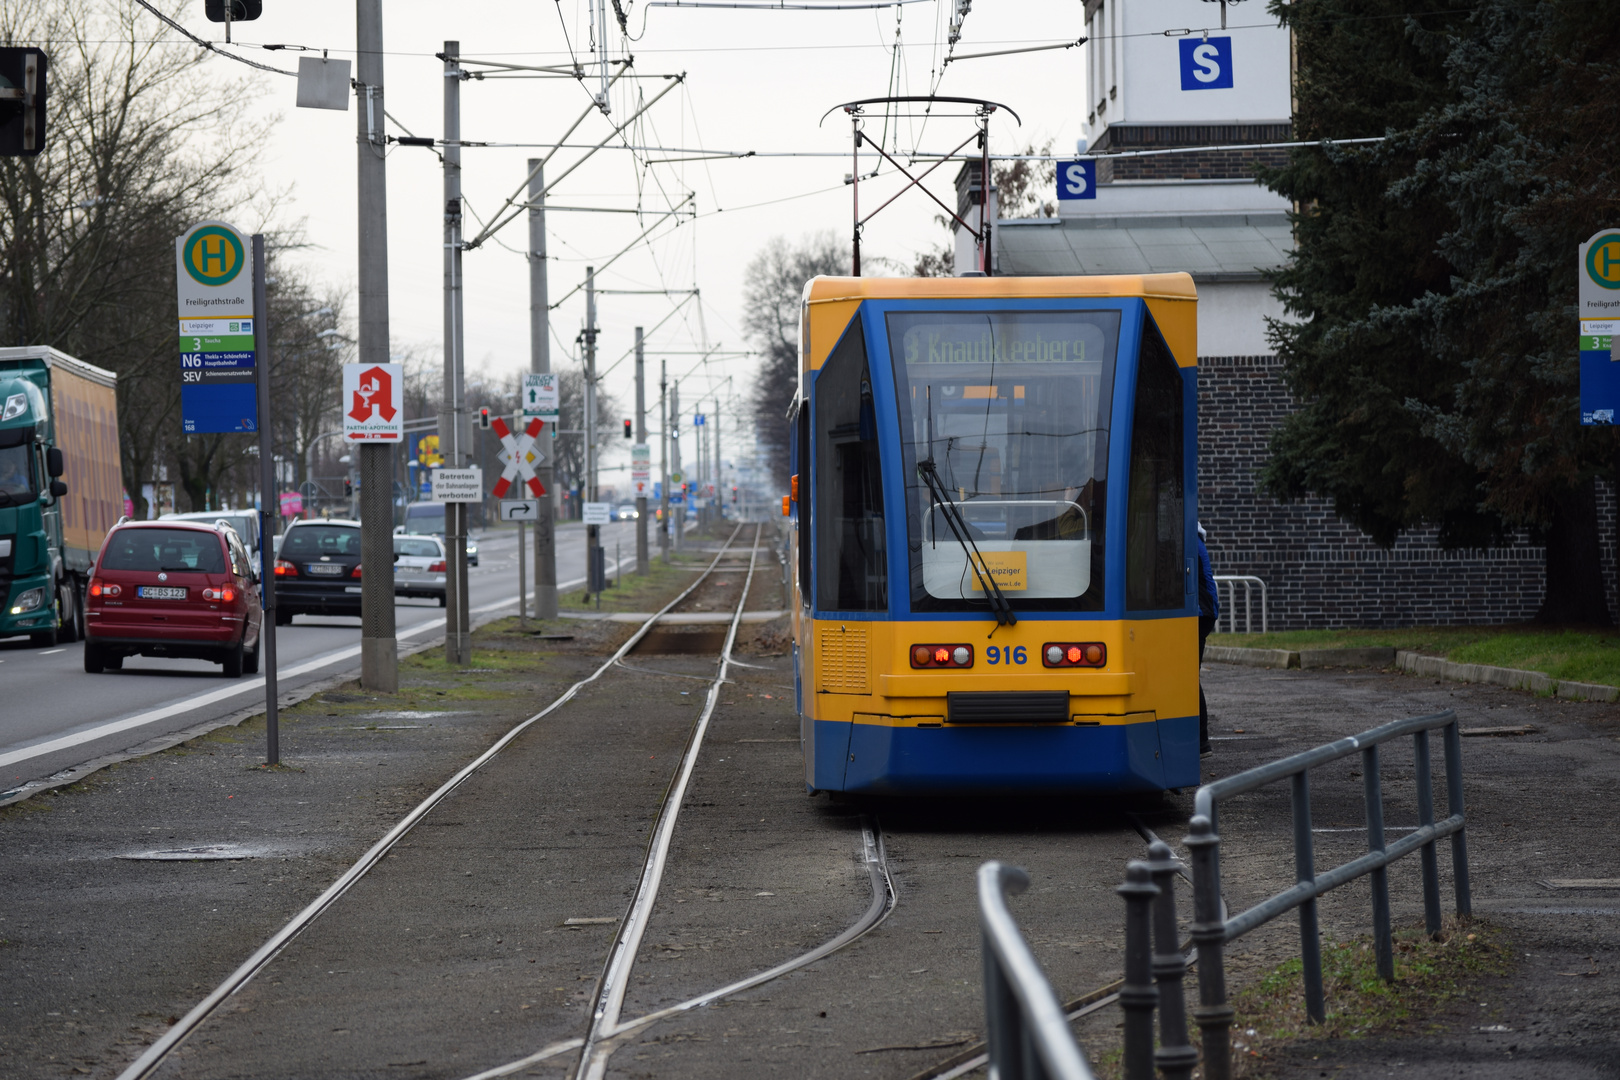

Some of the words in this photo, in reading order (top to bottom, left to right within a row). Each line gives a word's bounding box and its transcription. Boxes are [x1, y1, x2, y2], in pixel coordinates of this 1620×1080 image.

[1193, 44, 1220, 83] S
[1066, 165, 1087, 194] S
[201, 239, 226, 272] H
[185, 296, 245, 307] Freiligrathstraße
[192, 338, 202, 351] 3
[906, 333, 919, 363] 3
[1592, 336, 1600, 349] 3
[182, 354, 202, 368] N6
[183, 371, 202, 382] SEV
[142, 588, 152, 596] GC
[158, 588, 168, 596] BS
[170, 589, 184, 597] 123
[986, 646, 1028, 665] 916
